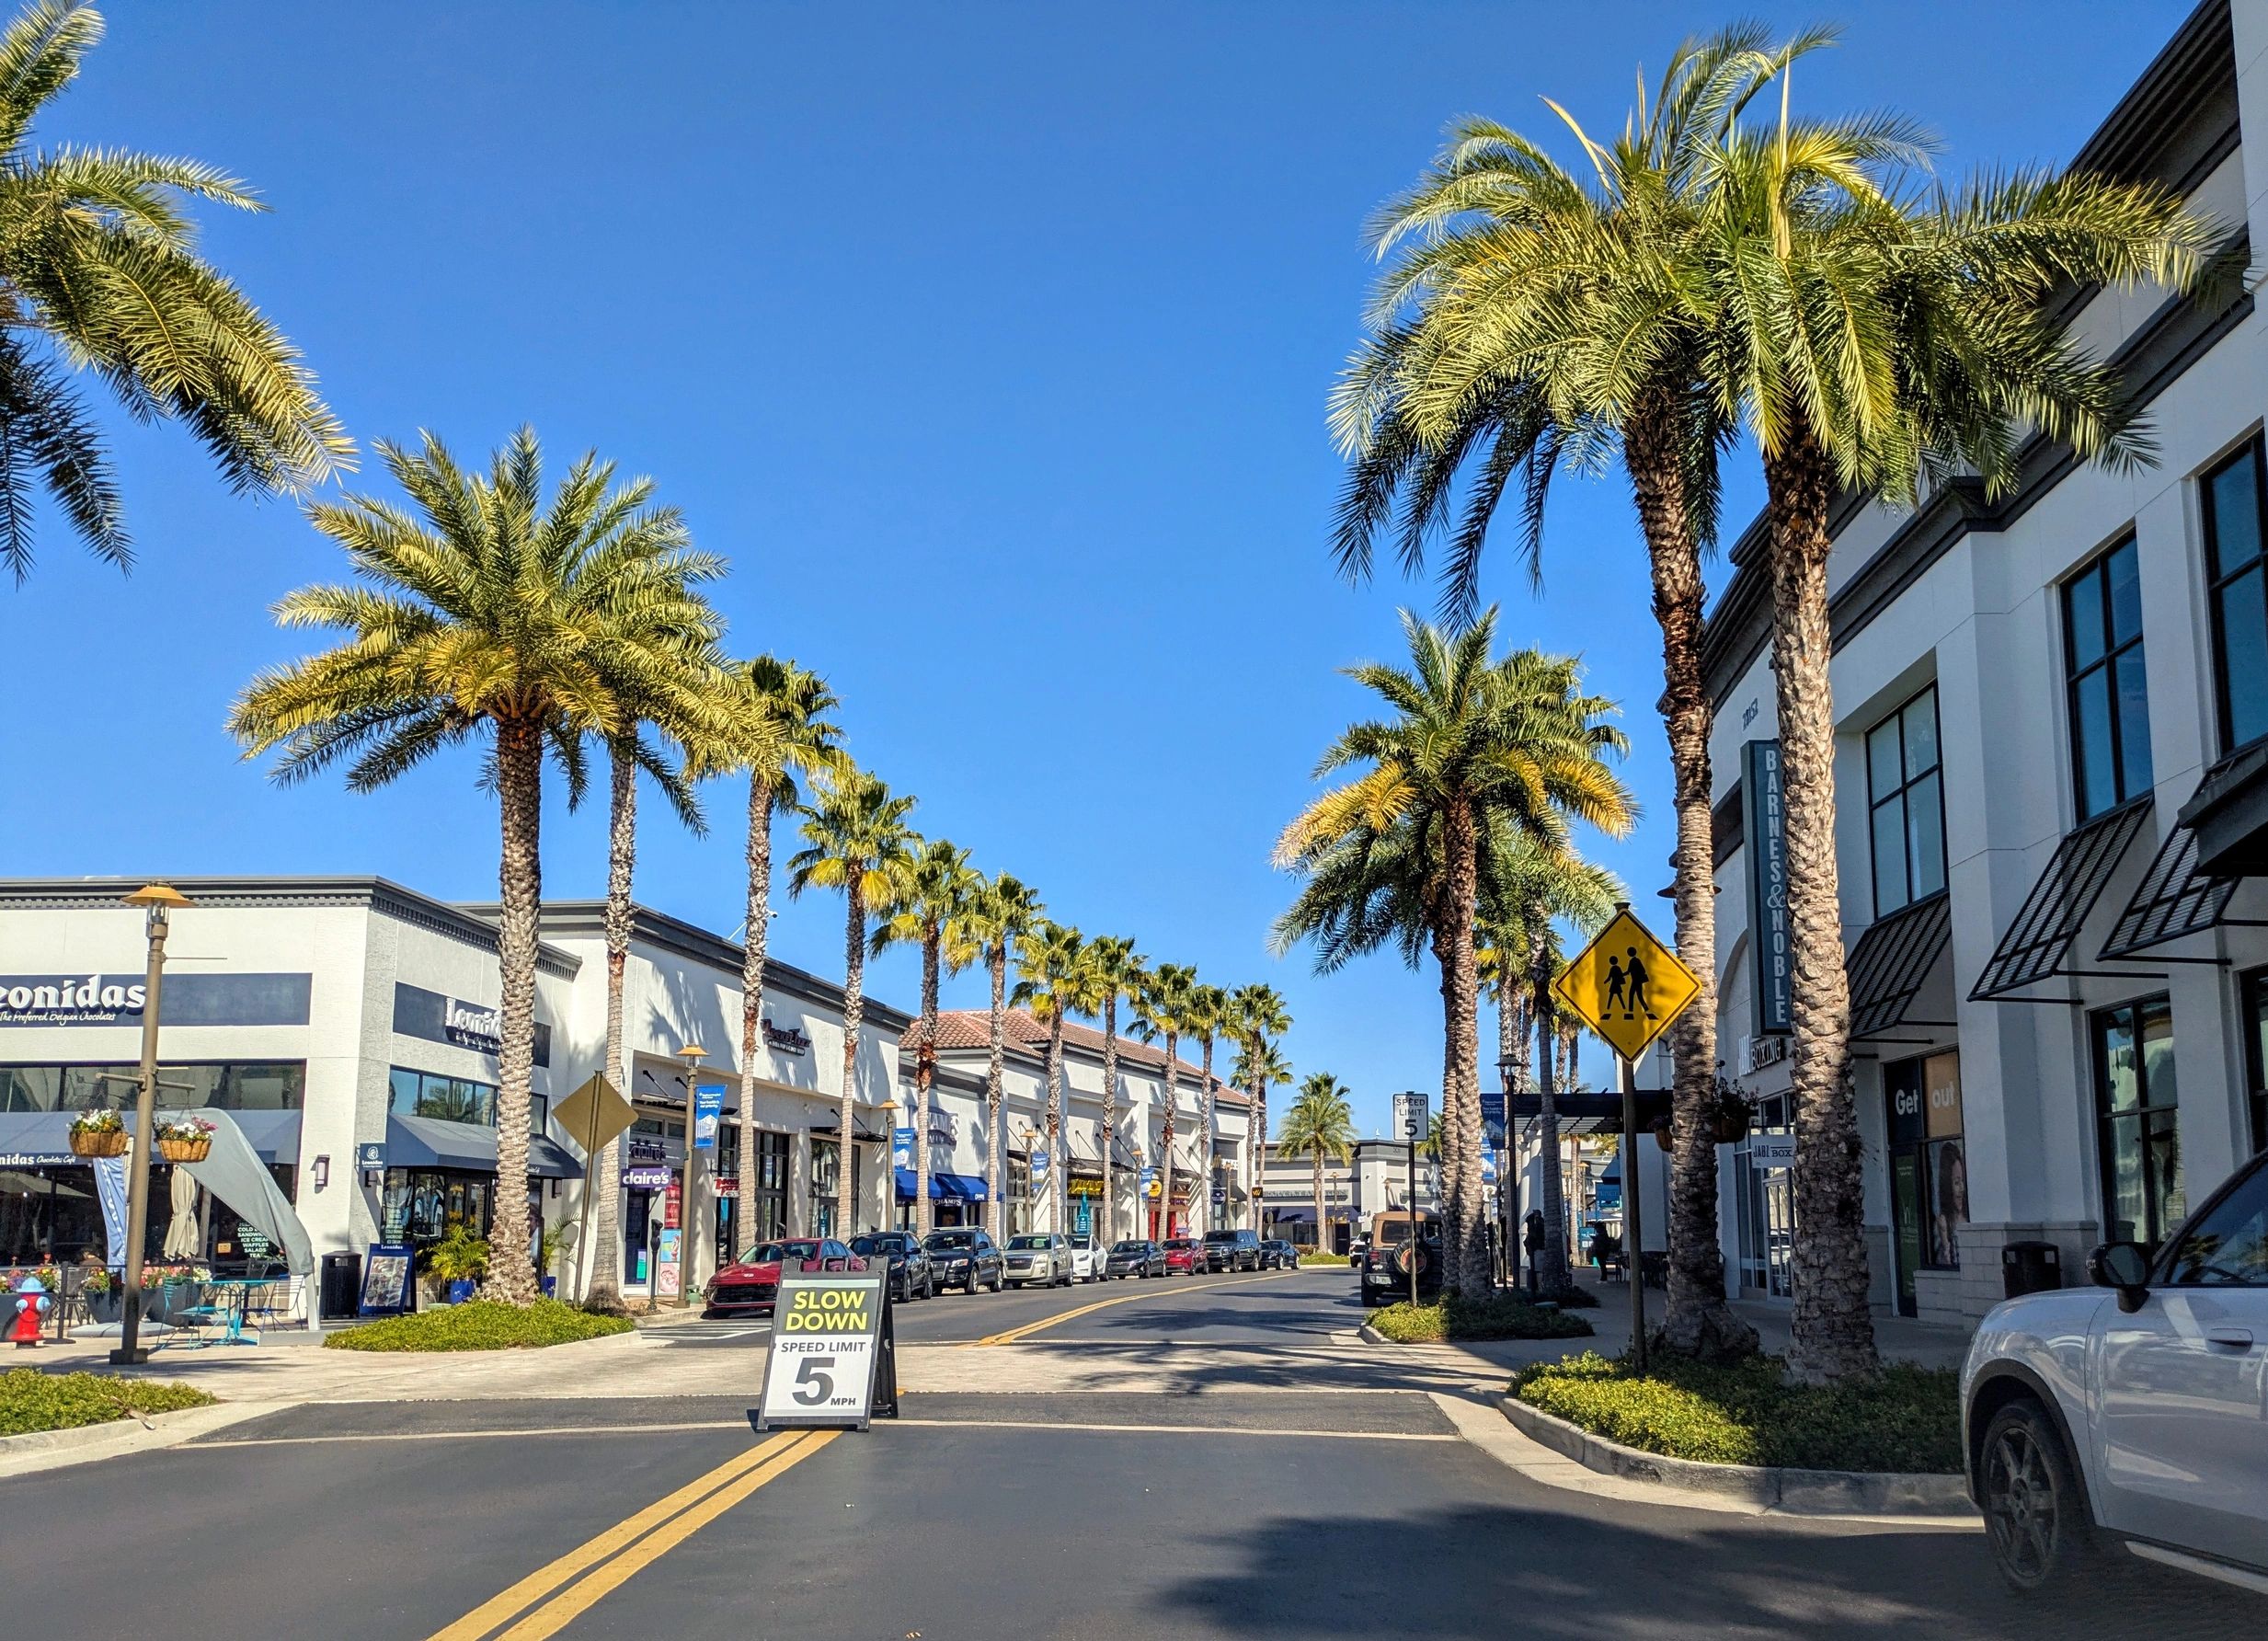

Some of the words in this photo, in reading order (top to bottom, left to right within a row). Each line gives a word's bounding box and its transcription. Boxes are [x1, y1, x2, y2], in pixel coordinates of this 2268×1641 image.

[1751, 1037, 1781, 1072] BOXING
[1396, 1098, 1426, 1107] SPEED
[1896, 1089, 1919, 1115] Get
[1932, 1081, 1954, 1108] out
[1399, 1108, 1423, 1117] LIMIT
[1404, 1119, 1418, 1137] 5
[622, 1171, 670, 1185] claire's
[934, 1198, 963, 1208] CHAMPS
[794, 1291, 866, 1310] SLOW
[785, 1313, 868, 1331] DOWN
[781, 1342, 825, 1352] SPEED
[828, 1341, 866, 1352] LIMIT
[792, 1357, 836, 1406] 5
[830, 1397, 856, 1406] MPH
